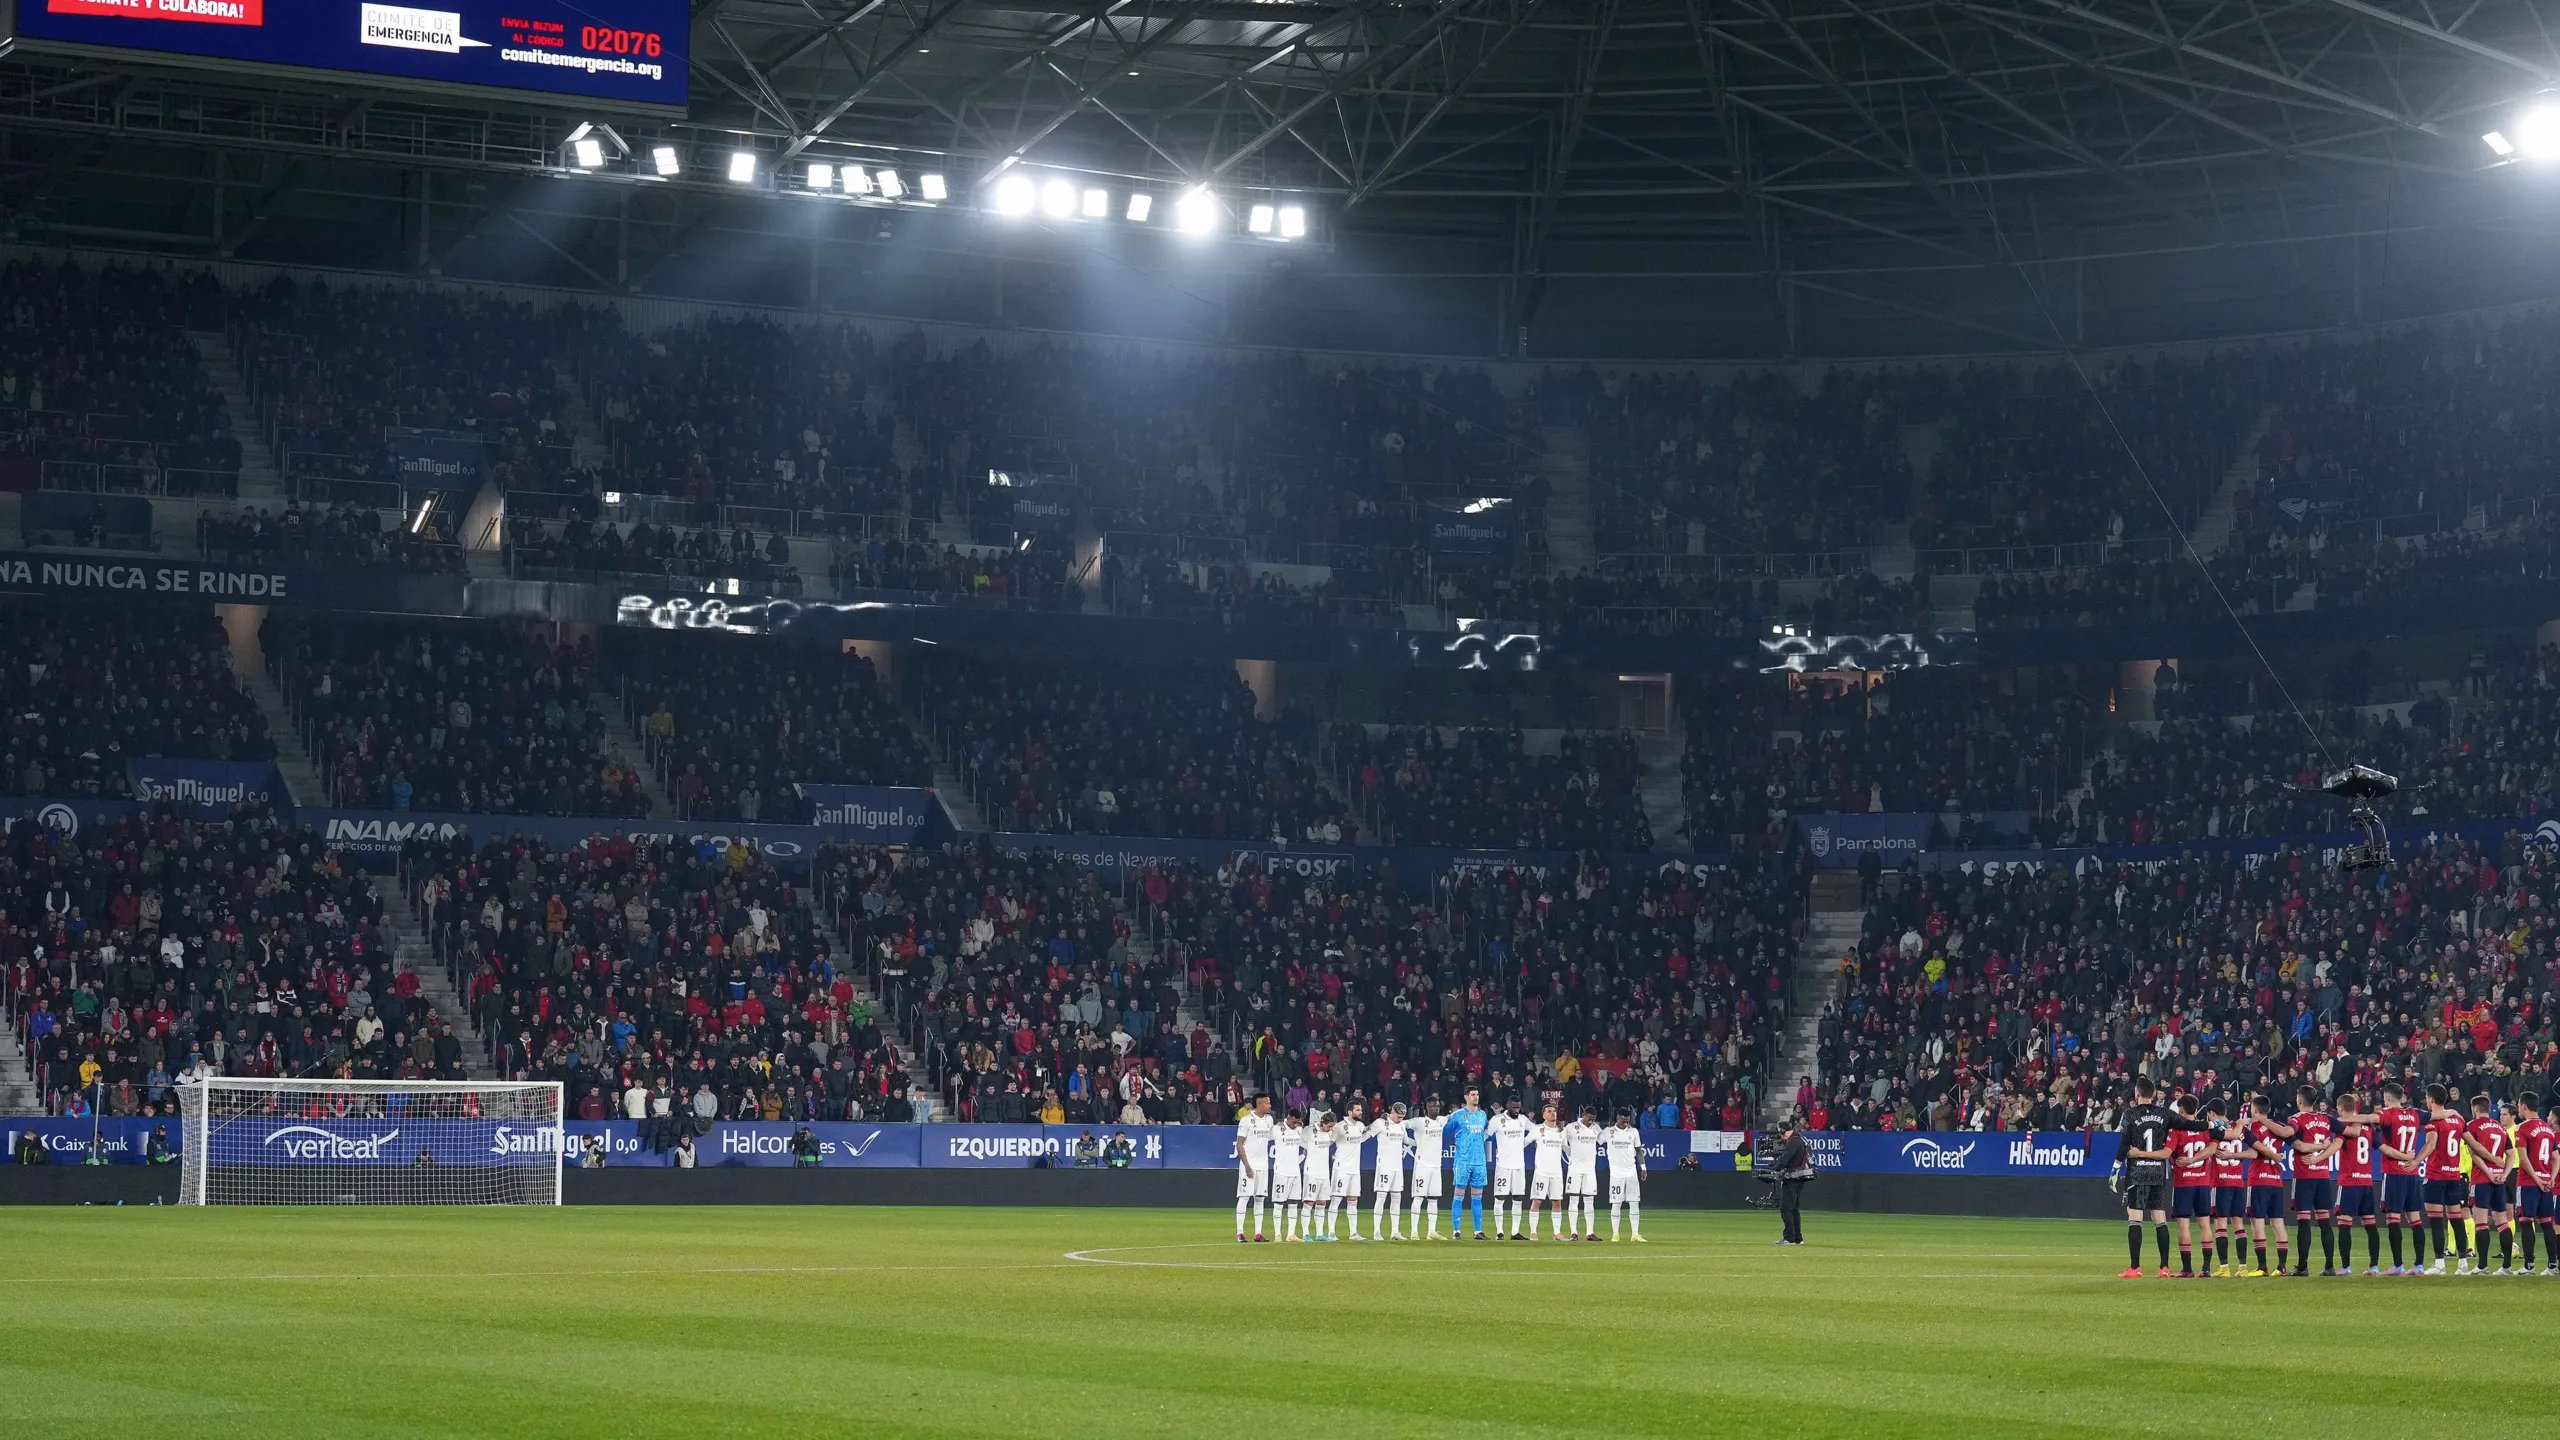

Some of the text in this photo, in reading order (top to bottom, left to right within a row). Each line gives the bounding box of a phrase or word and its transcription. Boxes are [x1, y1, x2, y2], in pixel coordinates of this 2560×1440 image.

[159, 0, 244, 18] COLABORA!
[434, 18, 453, 32] DE
[533, 21, 564, 33] BIZUM
[367, 25, 453, 46] EMERGENCIA
[581, 25, 661, 57] 02076
[501, 48, 662, 80] comiteemergencia.org
[42, 563, 147, 590] NUNCA
[155, 569, 190, 592] SE
[199, 571, 287, 598] RINDE
[136, 777, 244, 808] SanMiguel
[1094, 850, 1114, 866] de
[615, 1137, 638, 1155] 0,0
[1827, 1138, 1841, 1151] DE
[2143, 1128, 2153, 1153] 1
[2397, 1125, 2416, 1153] 17
[2447, 1129, 2459, 1158] 6
[2489, 1133, 2502, 1157] 7
[2357, 1136, 2369, 1165] 8
[2539, 1137, 2550, 1165] 4
[1242, 1178, 1247, 1188] 3
[1337, 1178, 1343, 1188] 6
[1380, 1173, 1389, 1184] 15
[1415, 1178, 1424, 1188] 12
[1497, 1177, 1507, 1188] 22
[1567, 1176, 1573, 1186] 4
[1276, 1183, 1285, 1193] 21
[1308, 1183, 1317, 1193] 10
[1536, 1182, 1544, 1192] 19
[1611, 1185, 1621, 1196] 20
